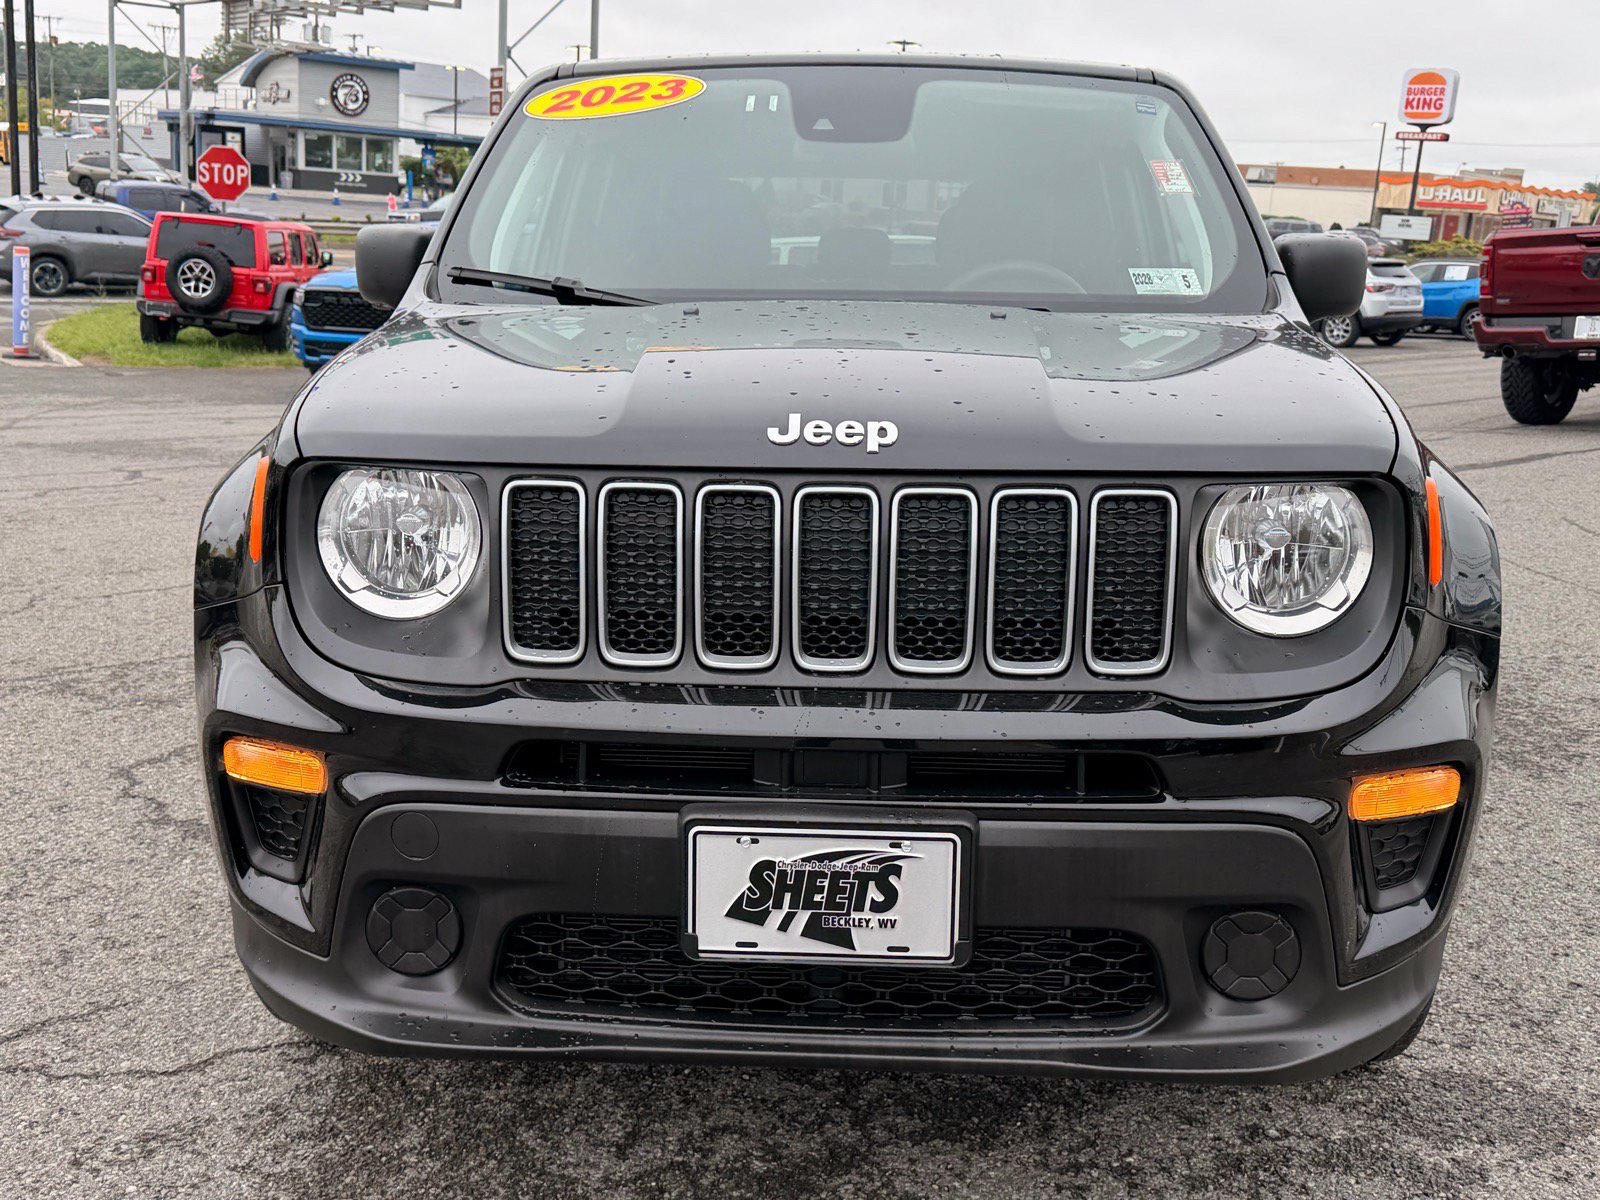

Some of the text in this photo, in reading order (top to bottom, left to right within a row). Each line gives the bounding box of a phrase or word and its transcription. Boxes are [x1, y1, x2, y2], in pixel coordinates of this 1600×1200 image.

[542, 79, 688, 115] 2023
[1406, 87, 1446, 97] BURGER
[1404, 97, 1444, 111] KING
[199, 161, 249, 186] STOP
[1419, 186, 1486, 203] U-HAUL
[1132, 273, 1154, 285] 2028
[1181, 274, 1192, 289] 5
[20, 256, 30, 344] WELCOME
[766, 412, 899, 454] Jeep
[744, 859, 903, 914] SHEETS
[823, 916, 898, 930] BECKLEY, WV
